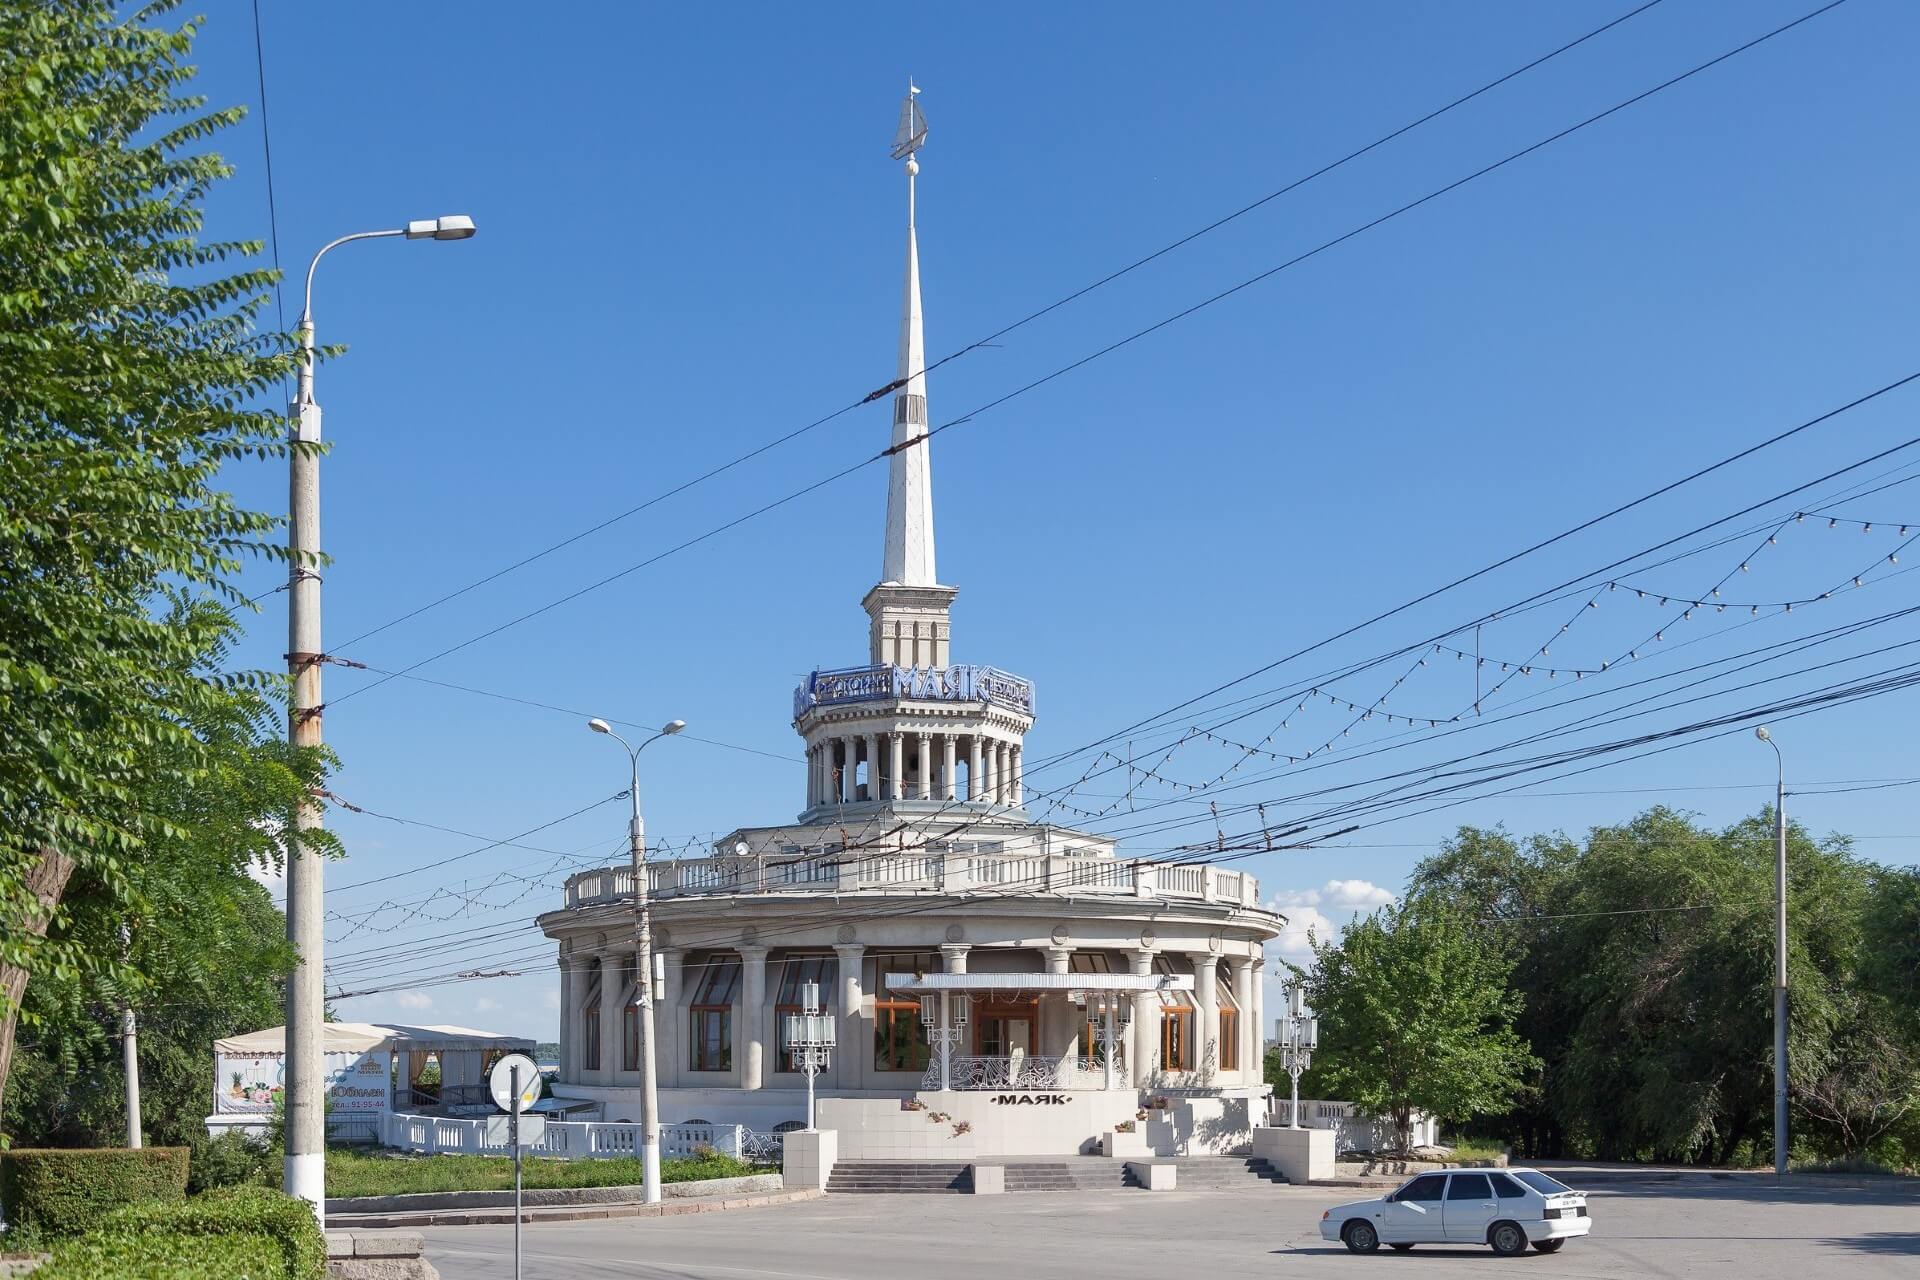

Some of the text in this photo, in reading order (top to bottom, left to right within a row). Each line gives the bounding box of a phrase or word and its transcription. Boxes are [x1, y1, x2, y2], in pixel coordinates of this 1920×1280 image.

[892, 662, 992, 702] МАЯК
[988, 676, 1028, 704] RESTAUR
[351, 1100, 385, 1108] 91-95-44
[998, 1095, 1066, 1105] МАЯК
